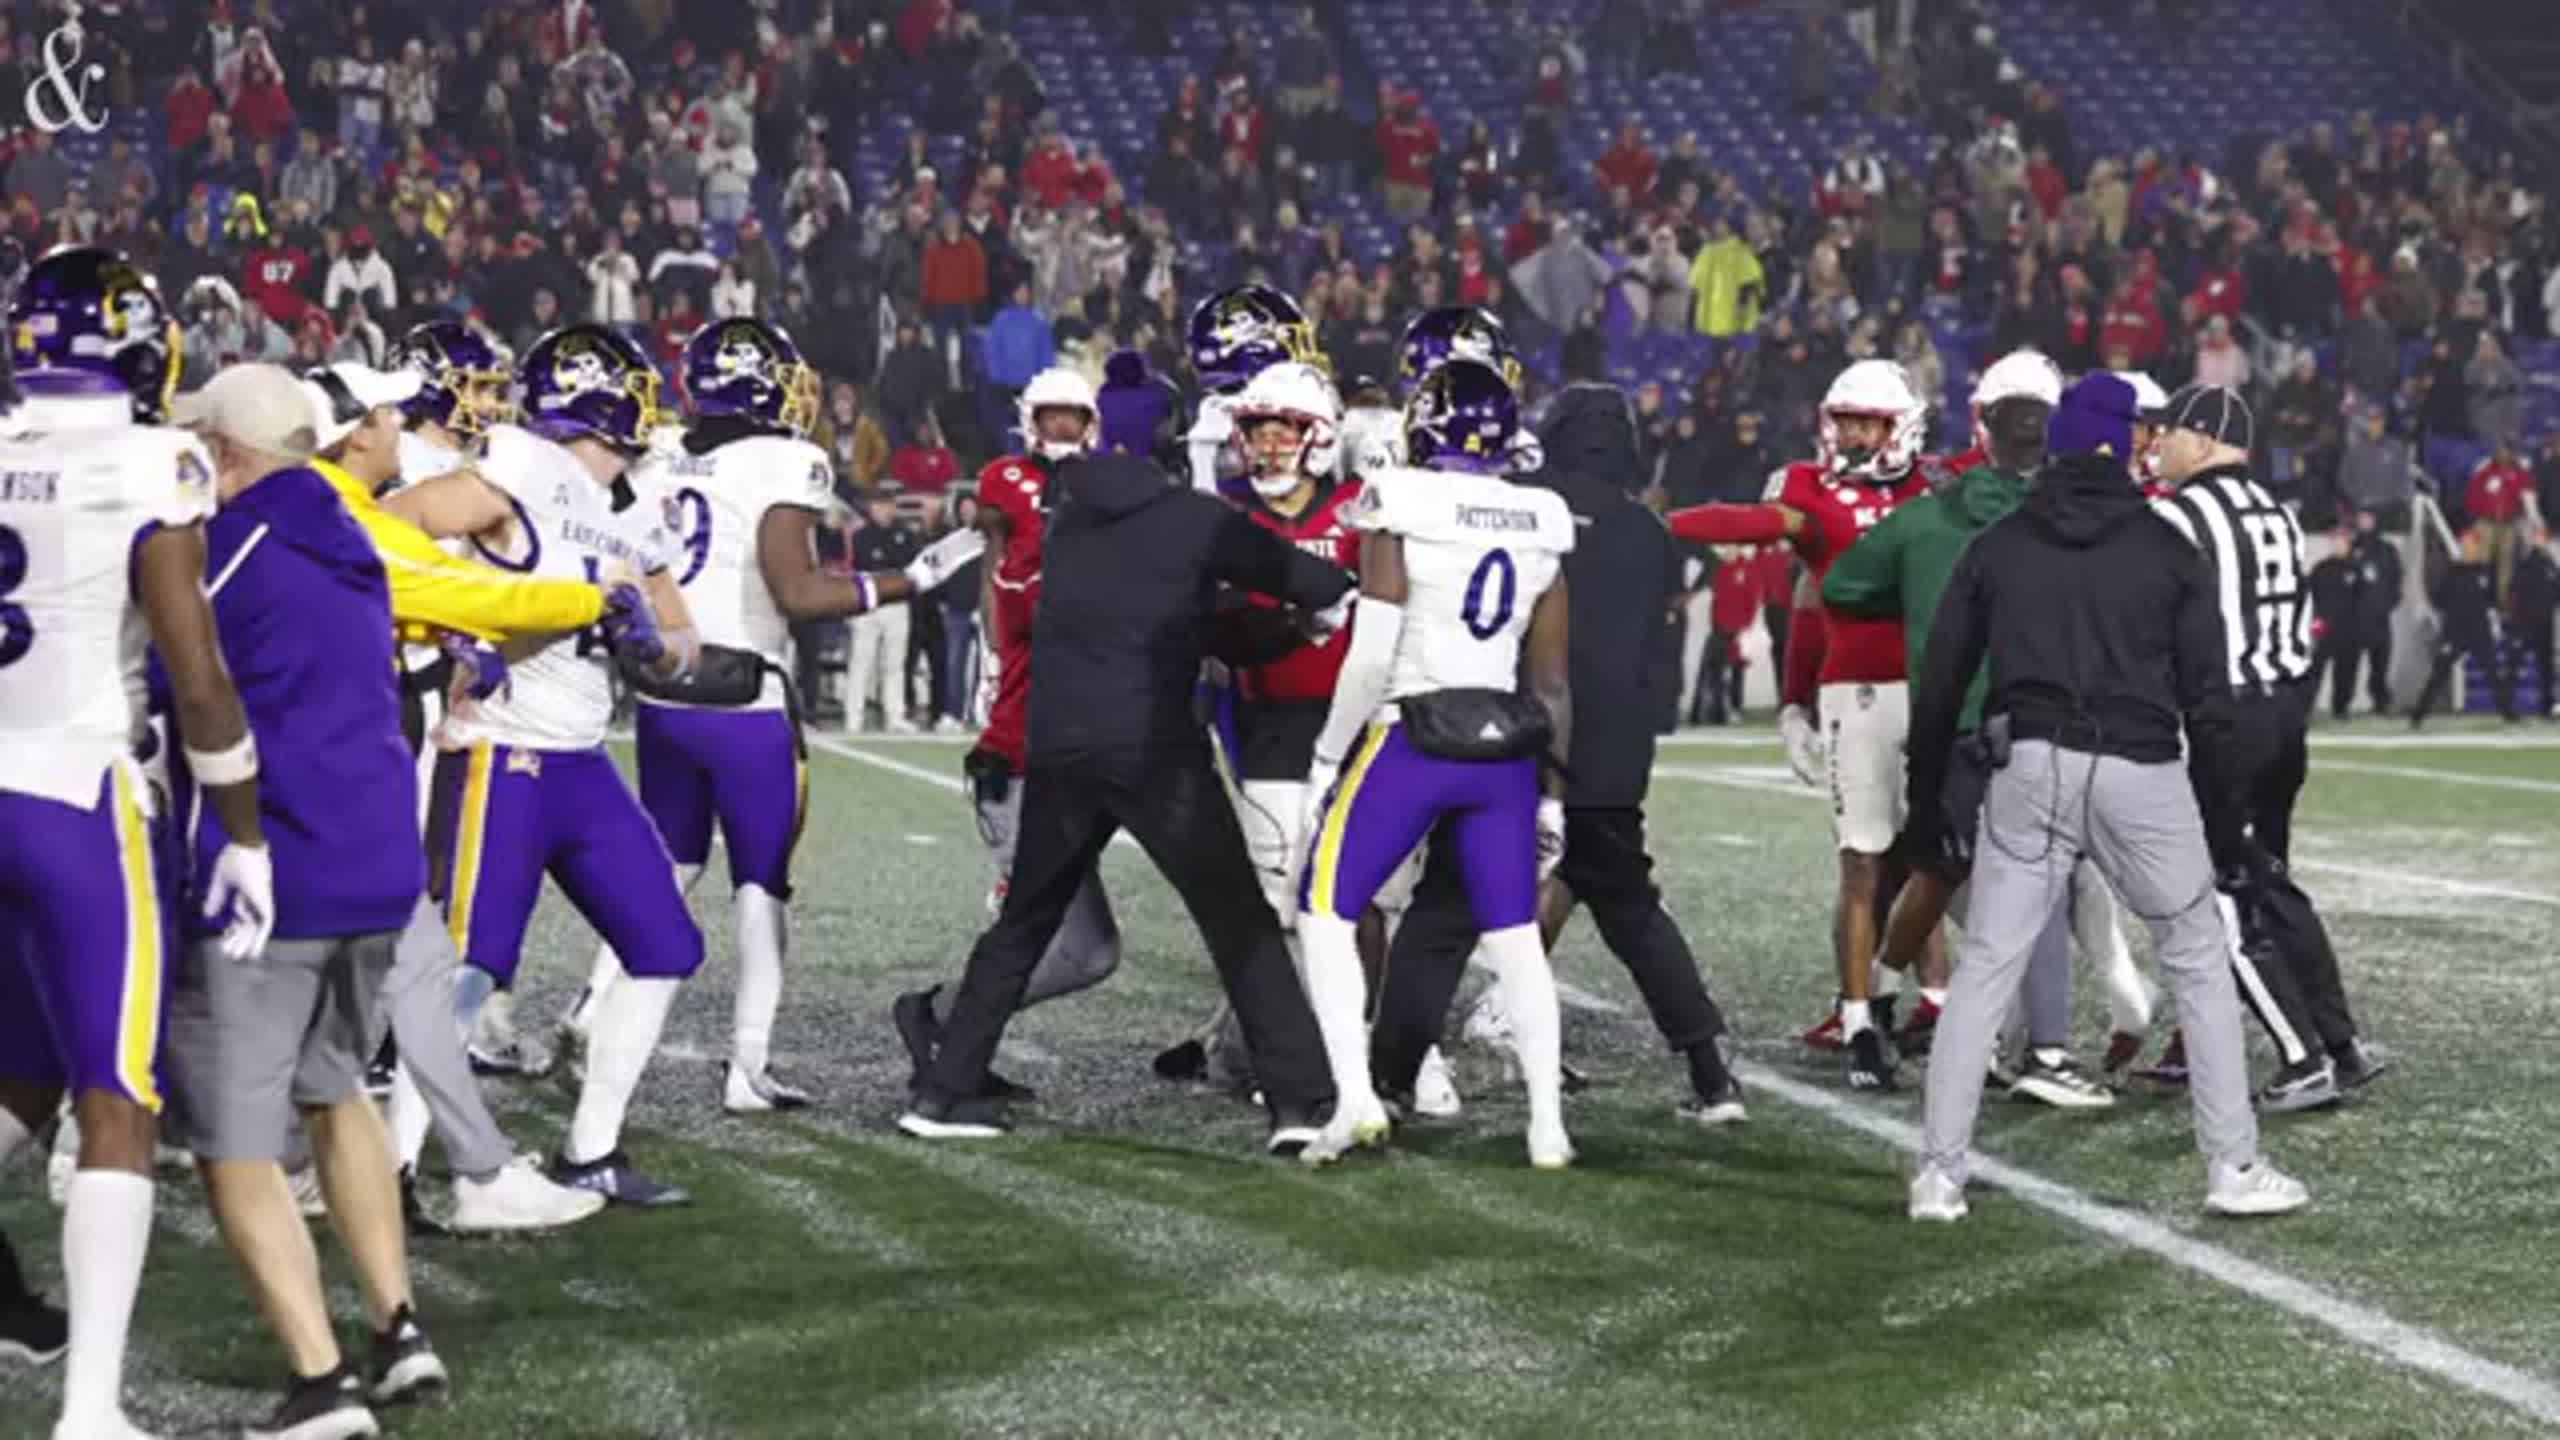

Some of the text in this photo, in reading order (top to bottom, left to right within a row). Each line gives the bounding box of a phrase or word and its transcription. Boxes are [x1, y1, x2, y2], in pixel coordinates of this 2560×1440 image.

[1456, 502, 1538, 532] PATTERSON
[2241, 514, 2297, 597] H
[1460, 547, 1516, 641] 0
